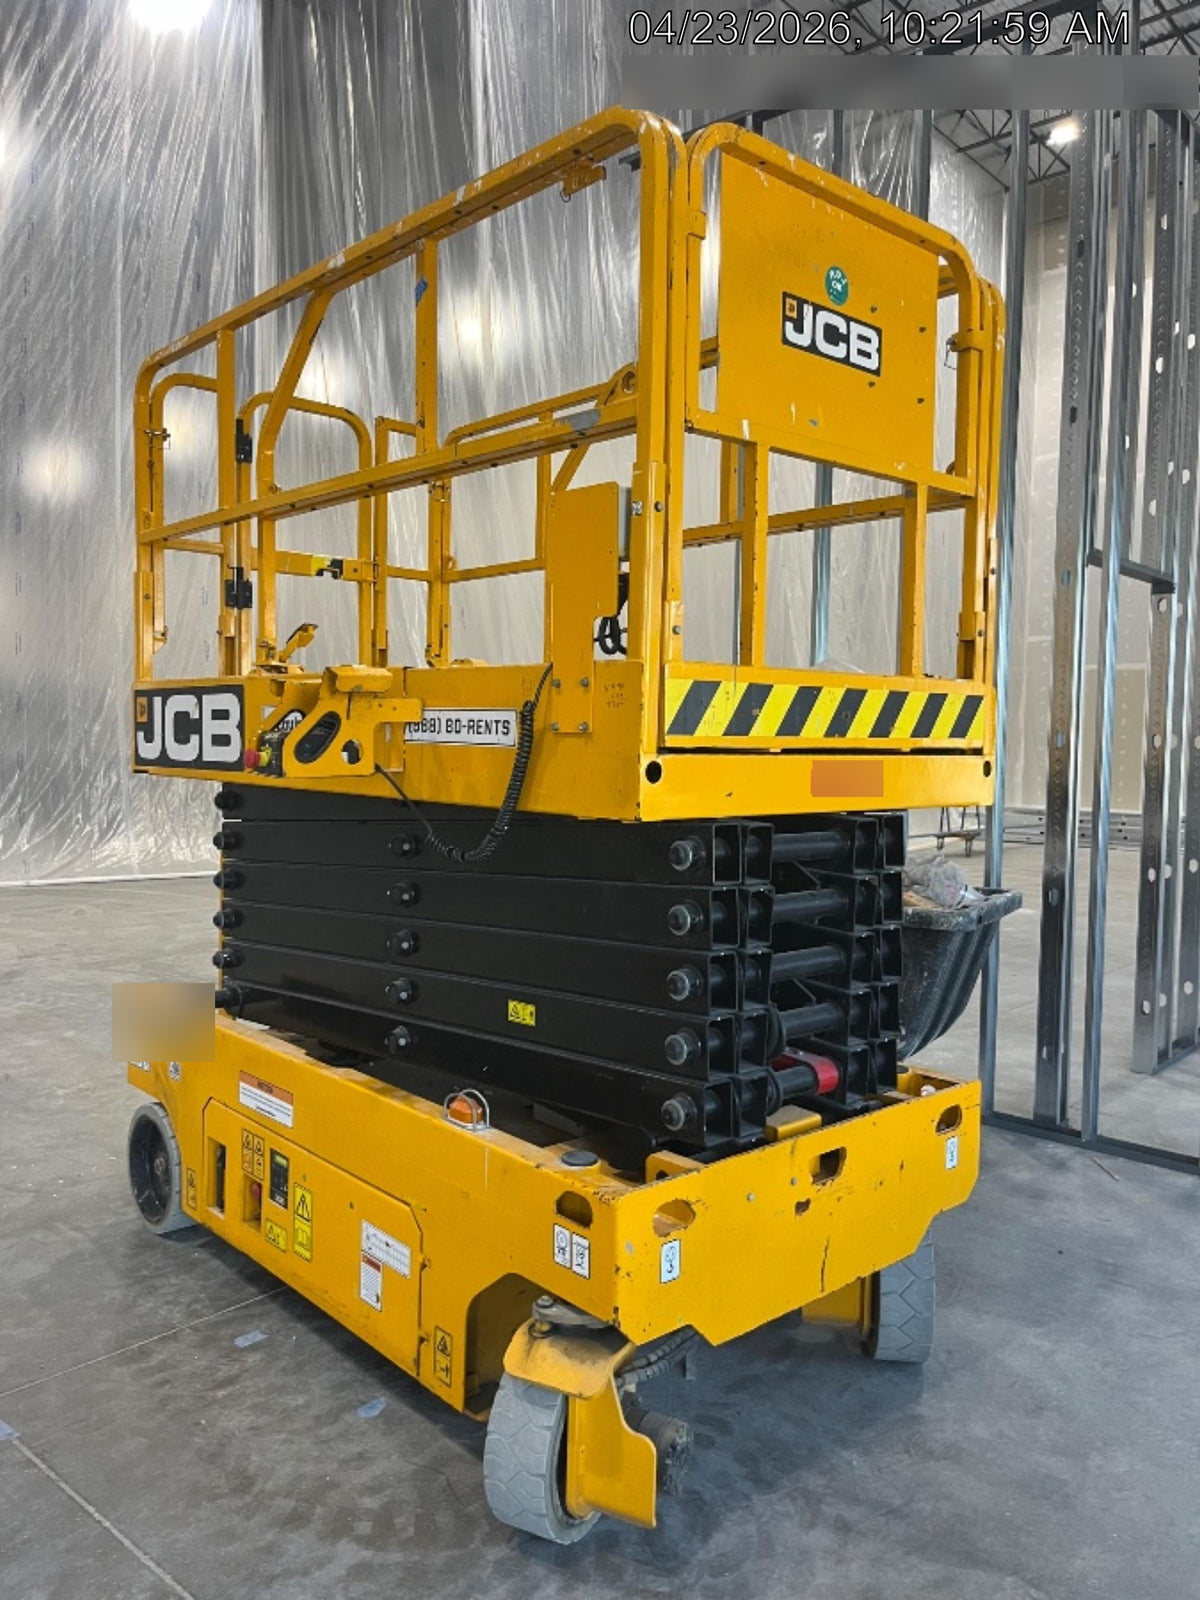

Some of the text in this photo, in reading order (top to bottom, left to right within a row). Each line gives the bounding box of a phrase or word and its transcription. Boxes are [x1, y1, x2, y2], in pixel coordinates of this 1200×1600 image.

[785, 303, 880, 370] JCB
[136, 693, 242, 763] JCB
[445, 718, 511, 736] 80-RENTS
